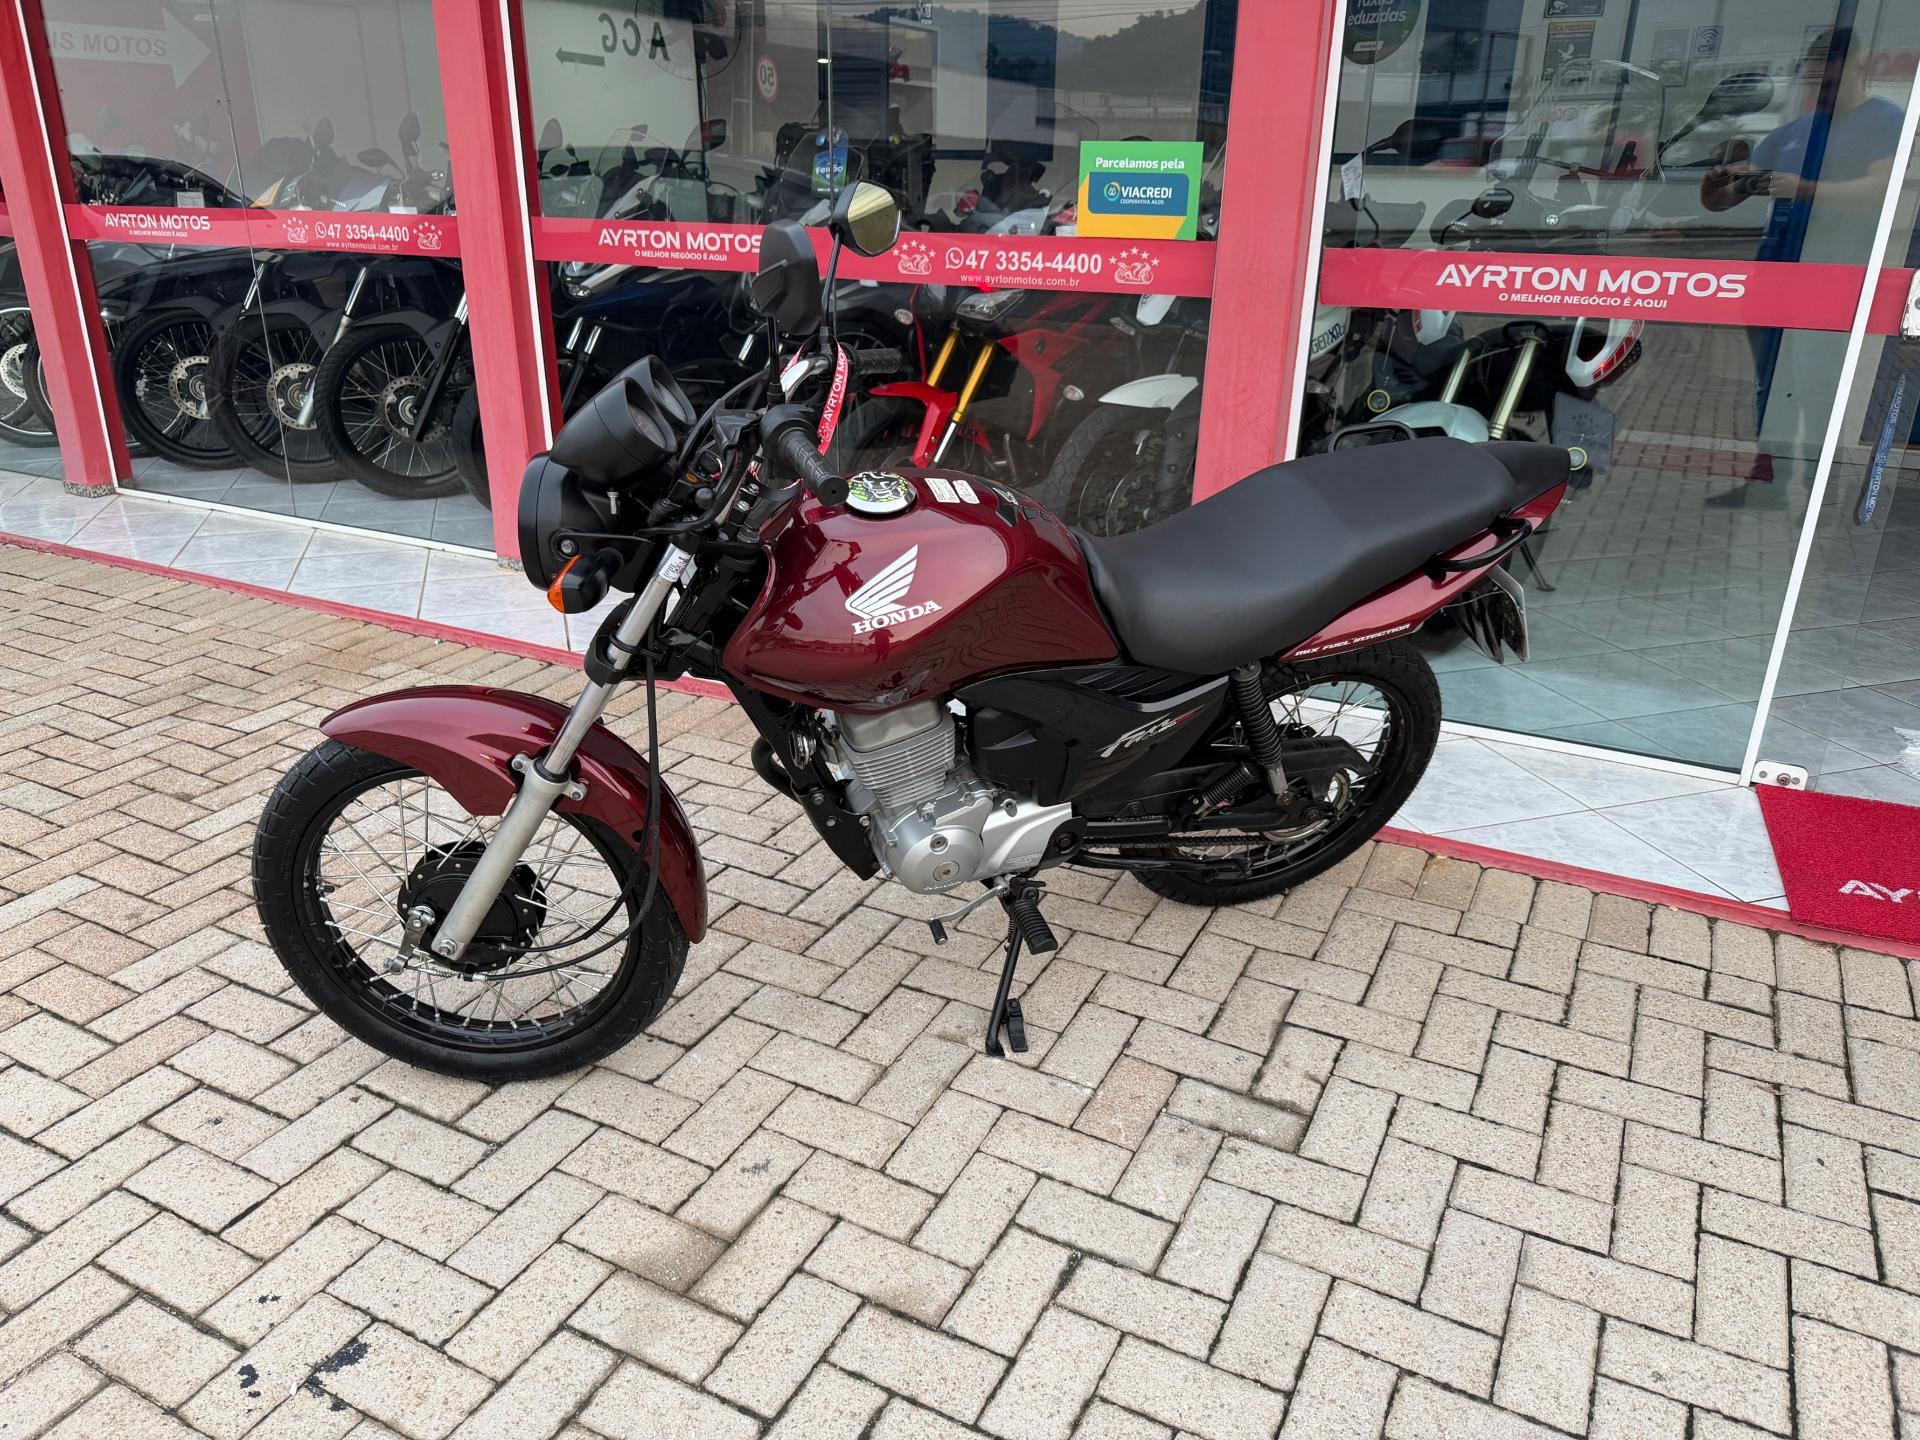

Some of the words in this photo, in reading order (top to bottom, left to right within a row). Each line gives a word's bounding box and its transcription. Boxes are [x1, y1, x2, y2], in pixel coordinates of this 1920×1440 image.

[1348, 8, 1407, 26] eduzidas
[83, 34, 167, 57] MOTOS
[1095, 157, 1158, 169] Parcelamos
[1160, 158, 1185, 171] pela
[1121, 186, 1173, 199] VIACREDI
[105, 212, 157, 229] AYRTON
[160, 214, 211, 231] MOTOS
[328, 223, 341, 238] 47
[345, 224, 410, 242] 3354-4400
[598, 228, 681, 249] AYRTON
[687, 231, 763, 254] MOTOS
[326, 241, 399, 251] www.ayrtonmotos.com.br
[642, 251, 669, 259] MELHOR
[671, 251, 702, 260] NEGÓCIO
[703, 252, 708, 261] É
[709, 254, 727, 262] AQUI
[965, 249, 990, 270] 47
[995, 250, 1102, 274] 3354-4400
[960, 273, 1080, 287] www.ayrtonmotos.com.br
[1435, 263, 1586, 292] AYRTON
[1597, 269, 1747, 299] MOTOS
[1498, 293, 1508, 302] O
[1510, 293, 1561, 304] MELHOR
[1563, 294, 1621, 306] NEGÓCIO
[1623, 296, 1631, 307] É
[1633, 298, 1667, 309] AQUI
[823, 375, 843, 422] AYRTON
[851, 600, 943, 636] HONDA
[1322, 640, 1350, 651] FUEL
[1352, 624, 1411, 643] INJECTION
[1838, 879, 1920, 904] AY
